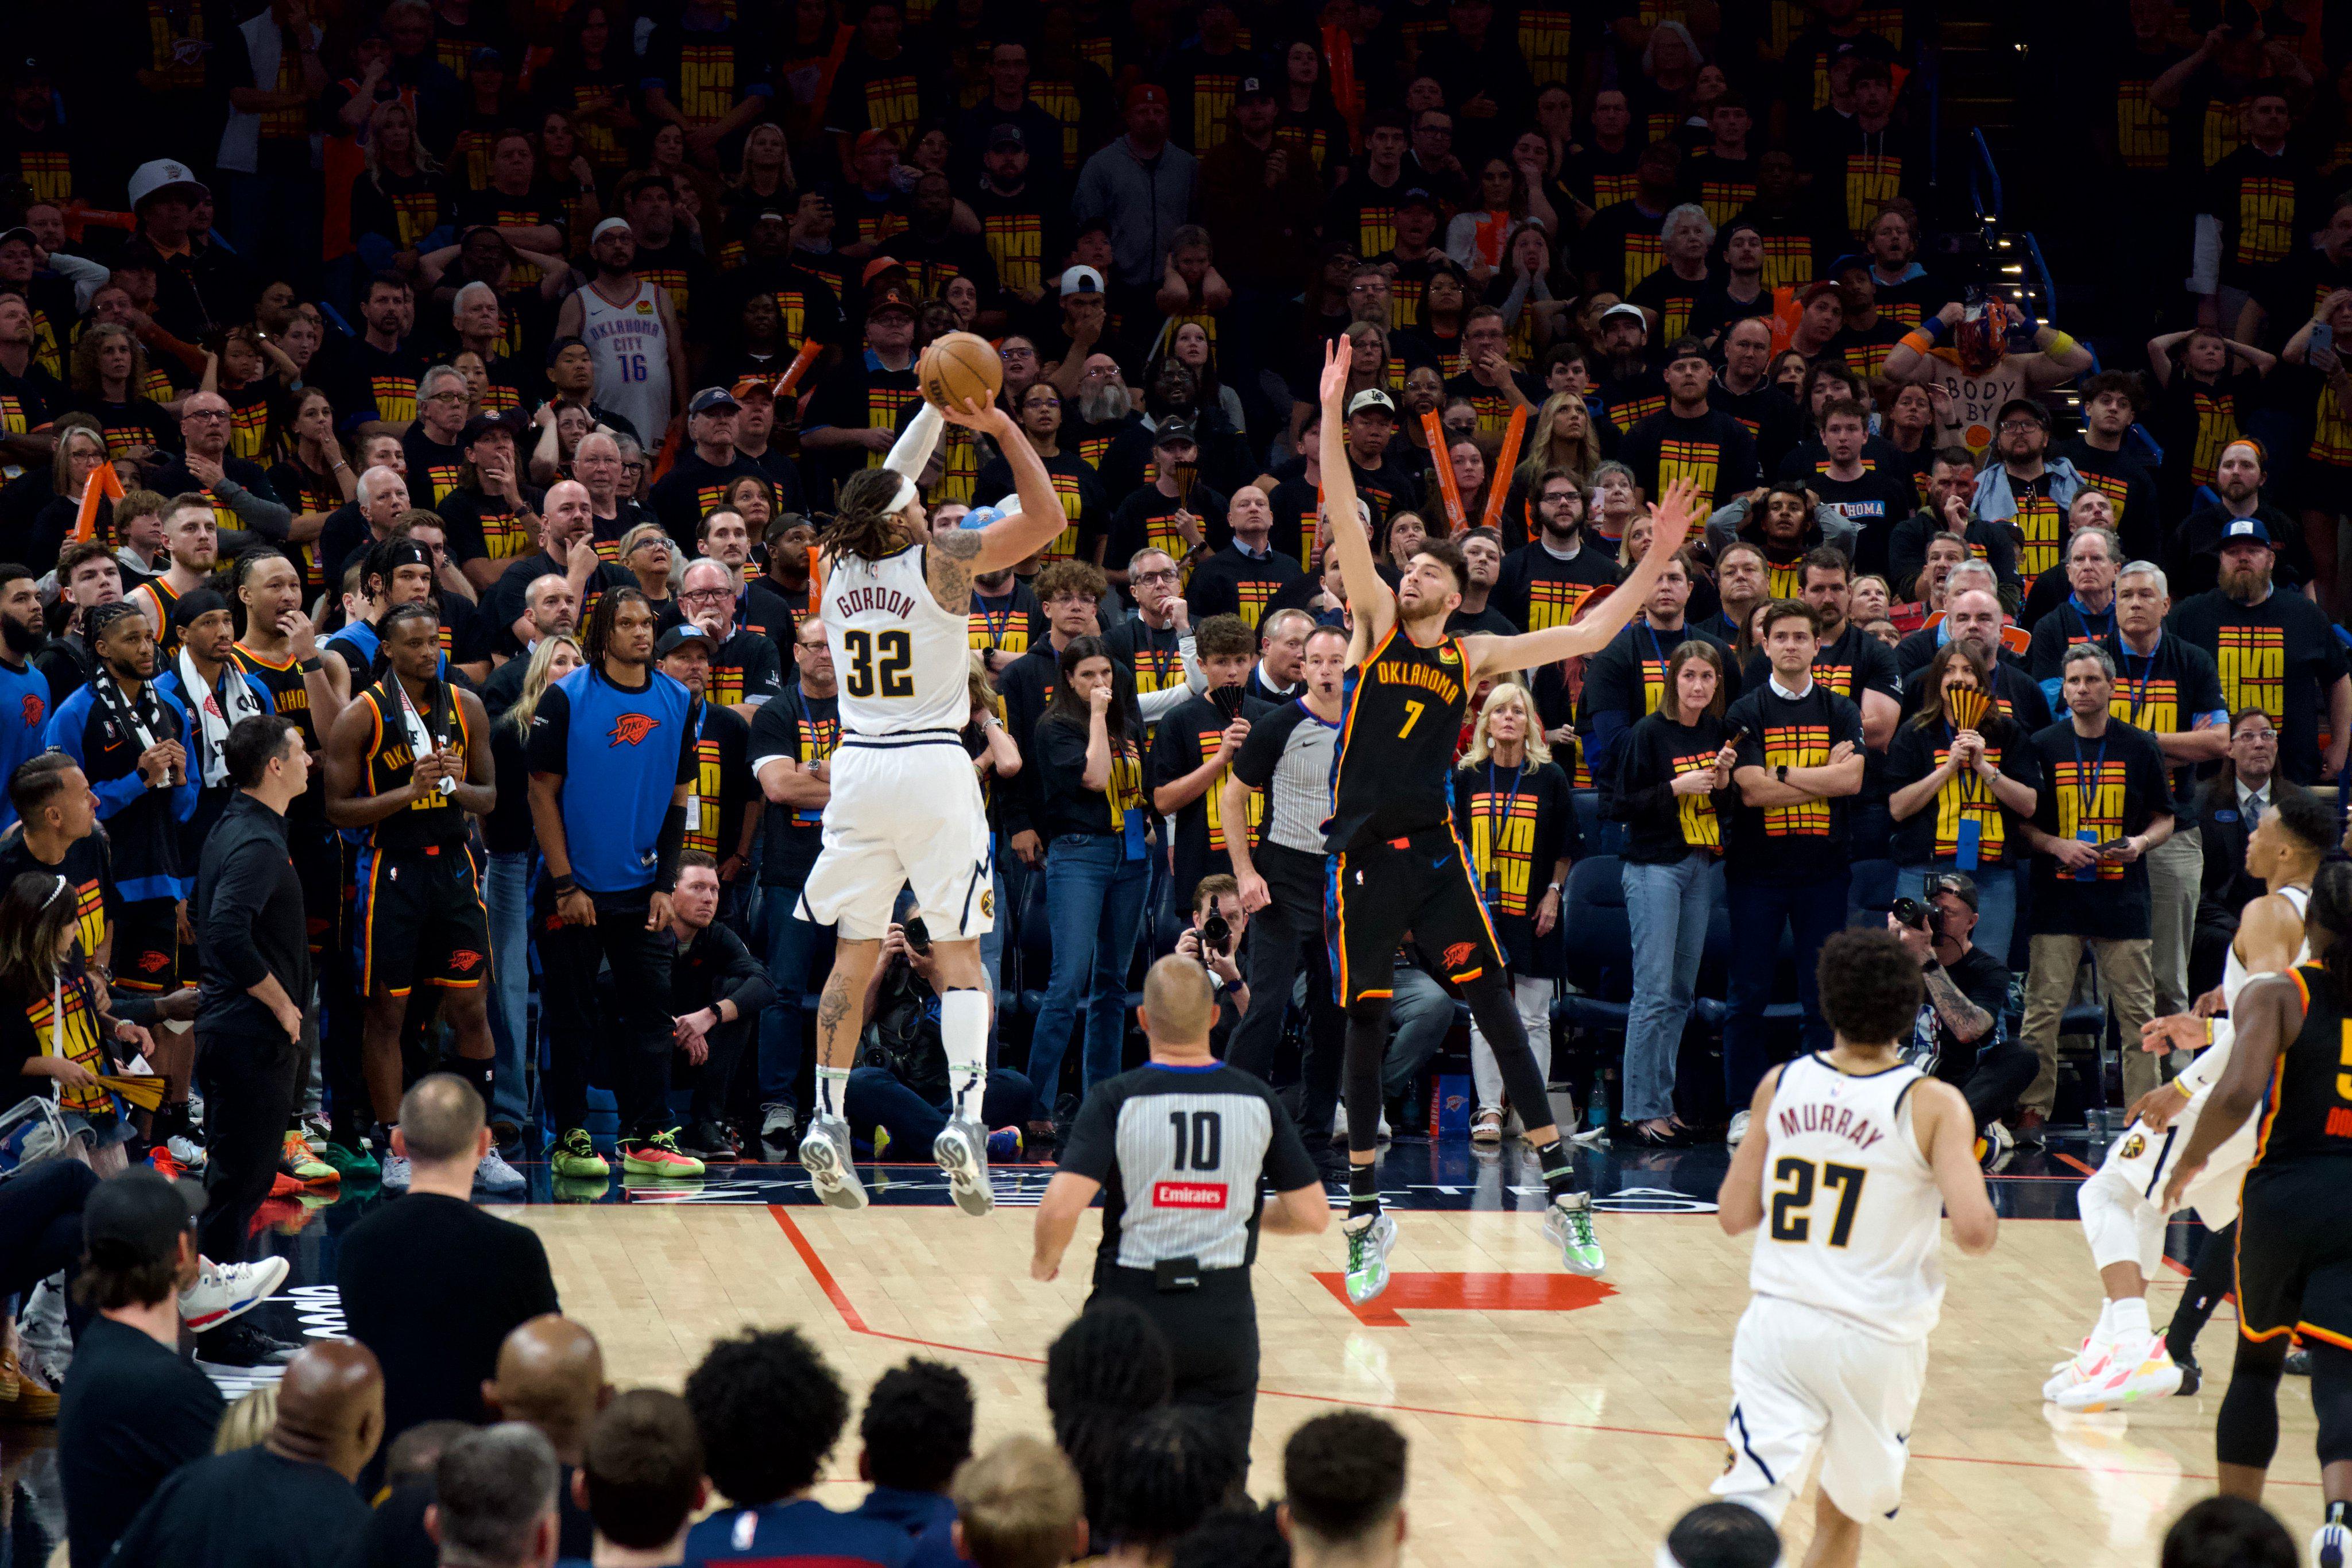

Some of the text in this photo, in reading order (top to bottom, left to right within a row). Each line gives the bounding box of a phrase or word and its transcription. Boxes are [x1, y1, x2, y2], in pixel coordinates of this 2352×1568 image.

[589, 319, 659, 340] OKLAHOMA
[613, 336, 642, 351] CITY
[617, 353, 648, 384] 16
[1945, 377, 2015, 402] BODY
[1966, 402, 1993, 421] BY
[836, 587, 916, 620] GORDON
[844, 629, 915, 697] 32
[1377, 660, 1460, 706] OKLAHOMA
[1397, 699, 1425, 740] 7
[1170, 1111, 1221, 1171] 10
[1780, 1104, 1884, 1151] MURRAY
[1159, 1186, 1222, 1203] Emirates
[1771, 1156, 1869, 1246] 27
